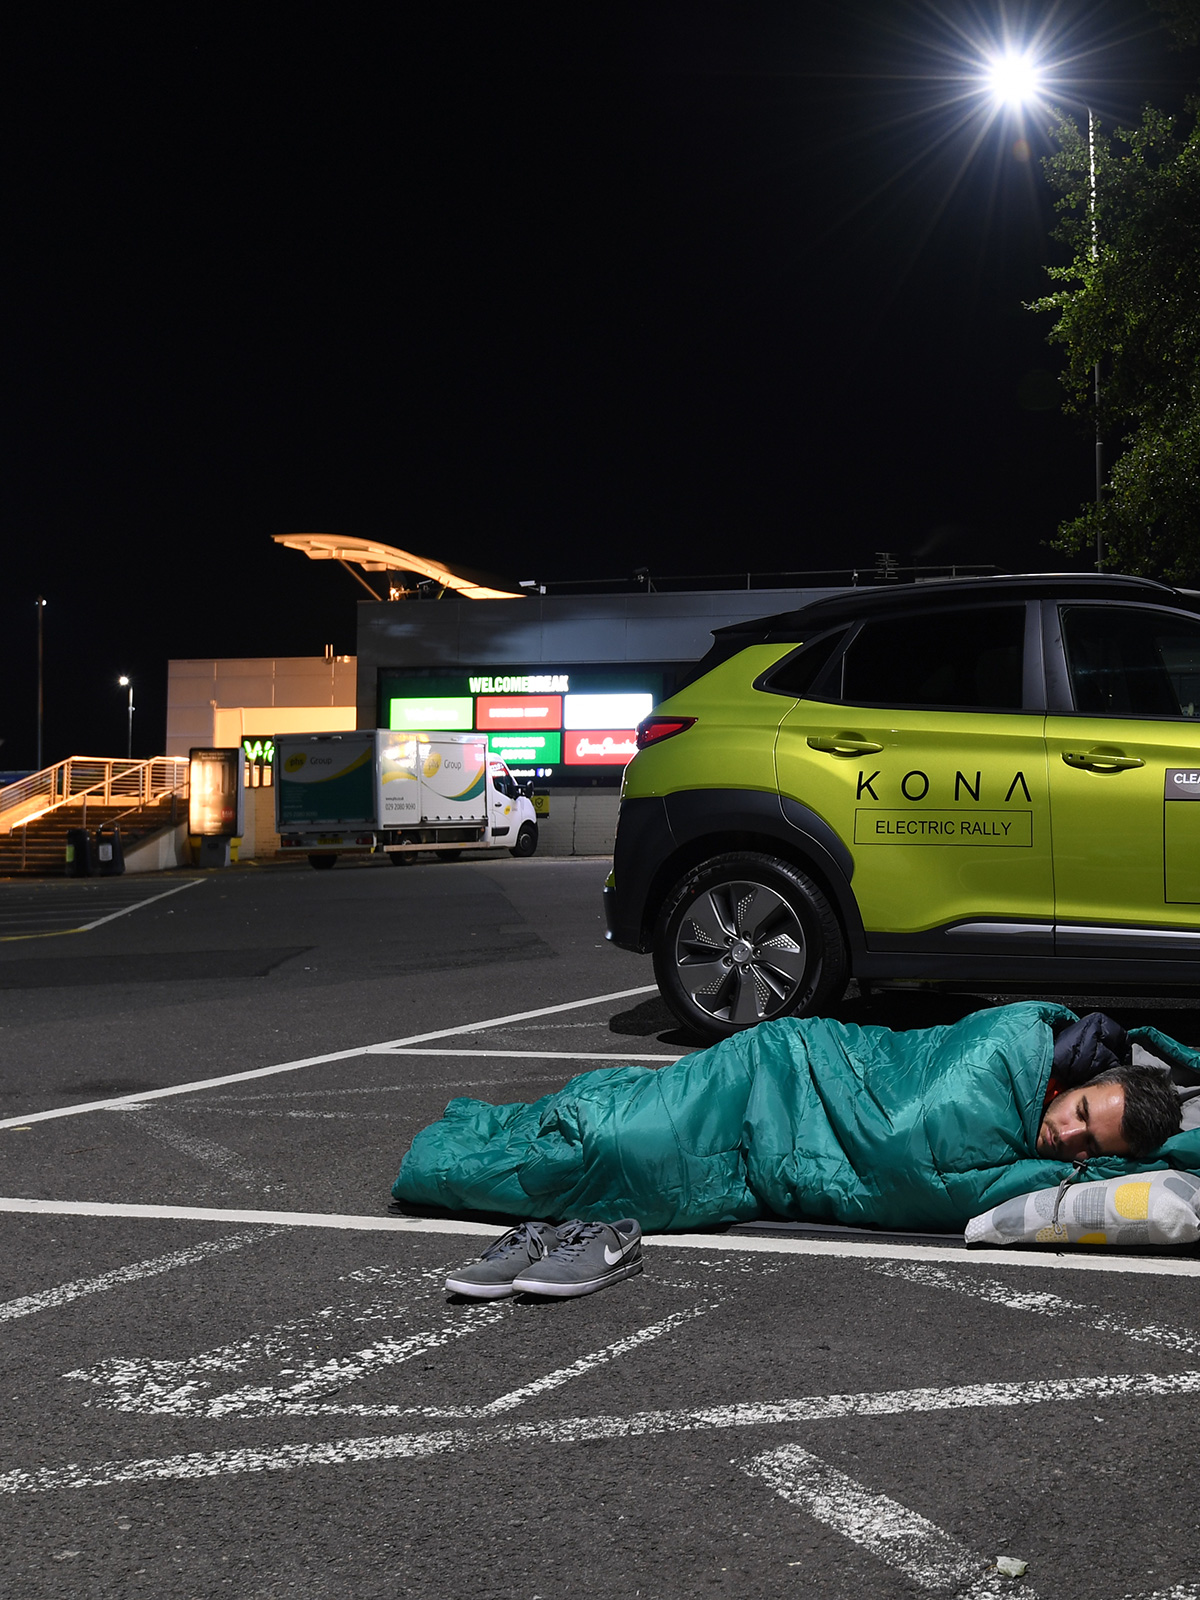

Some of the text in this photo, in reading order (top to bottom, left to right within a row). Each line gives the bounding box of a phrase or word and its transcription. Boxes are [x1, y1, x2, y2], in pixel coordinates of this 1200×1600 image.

[310, 757, 333, 766] Group
[444, 759, 462, 771] Group
[876, 820, 1012, 836] ELECTRIC RALLY
